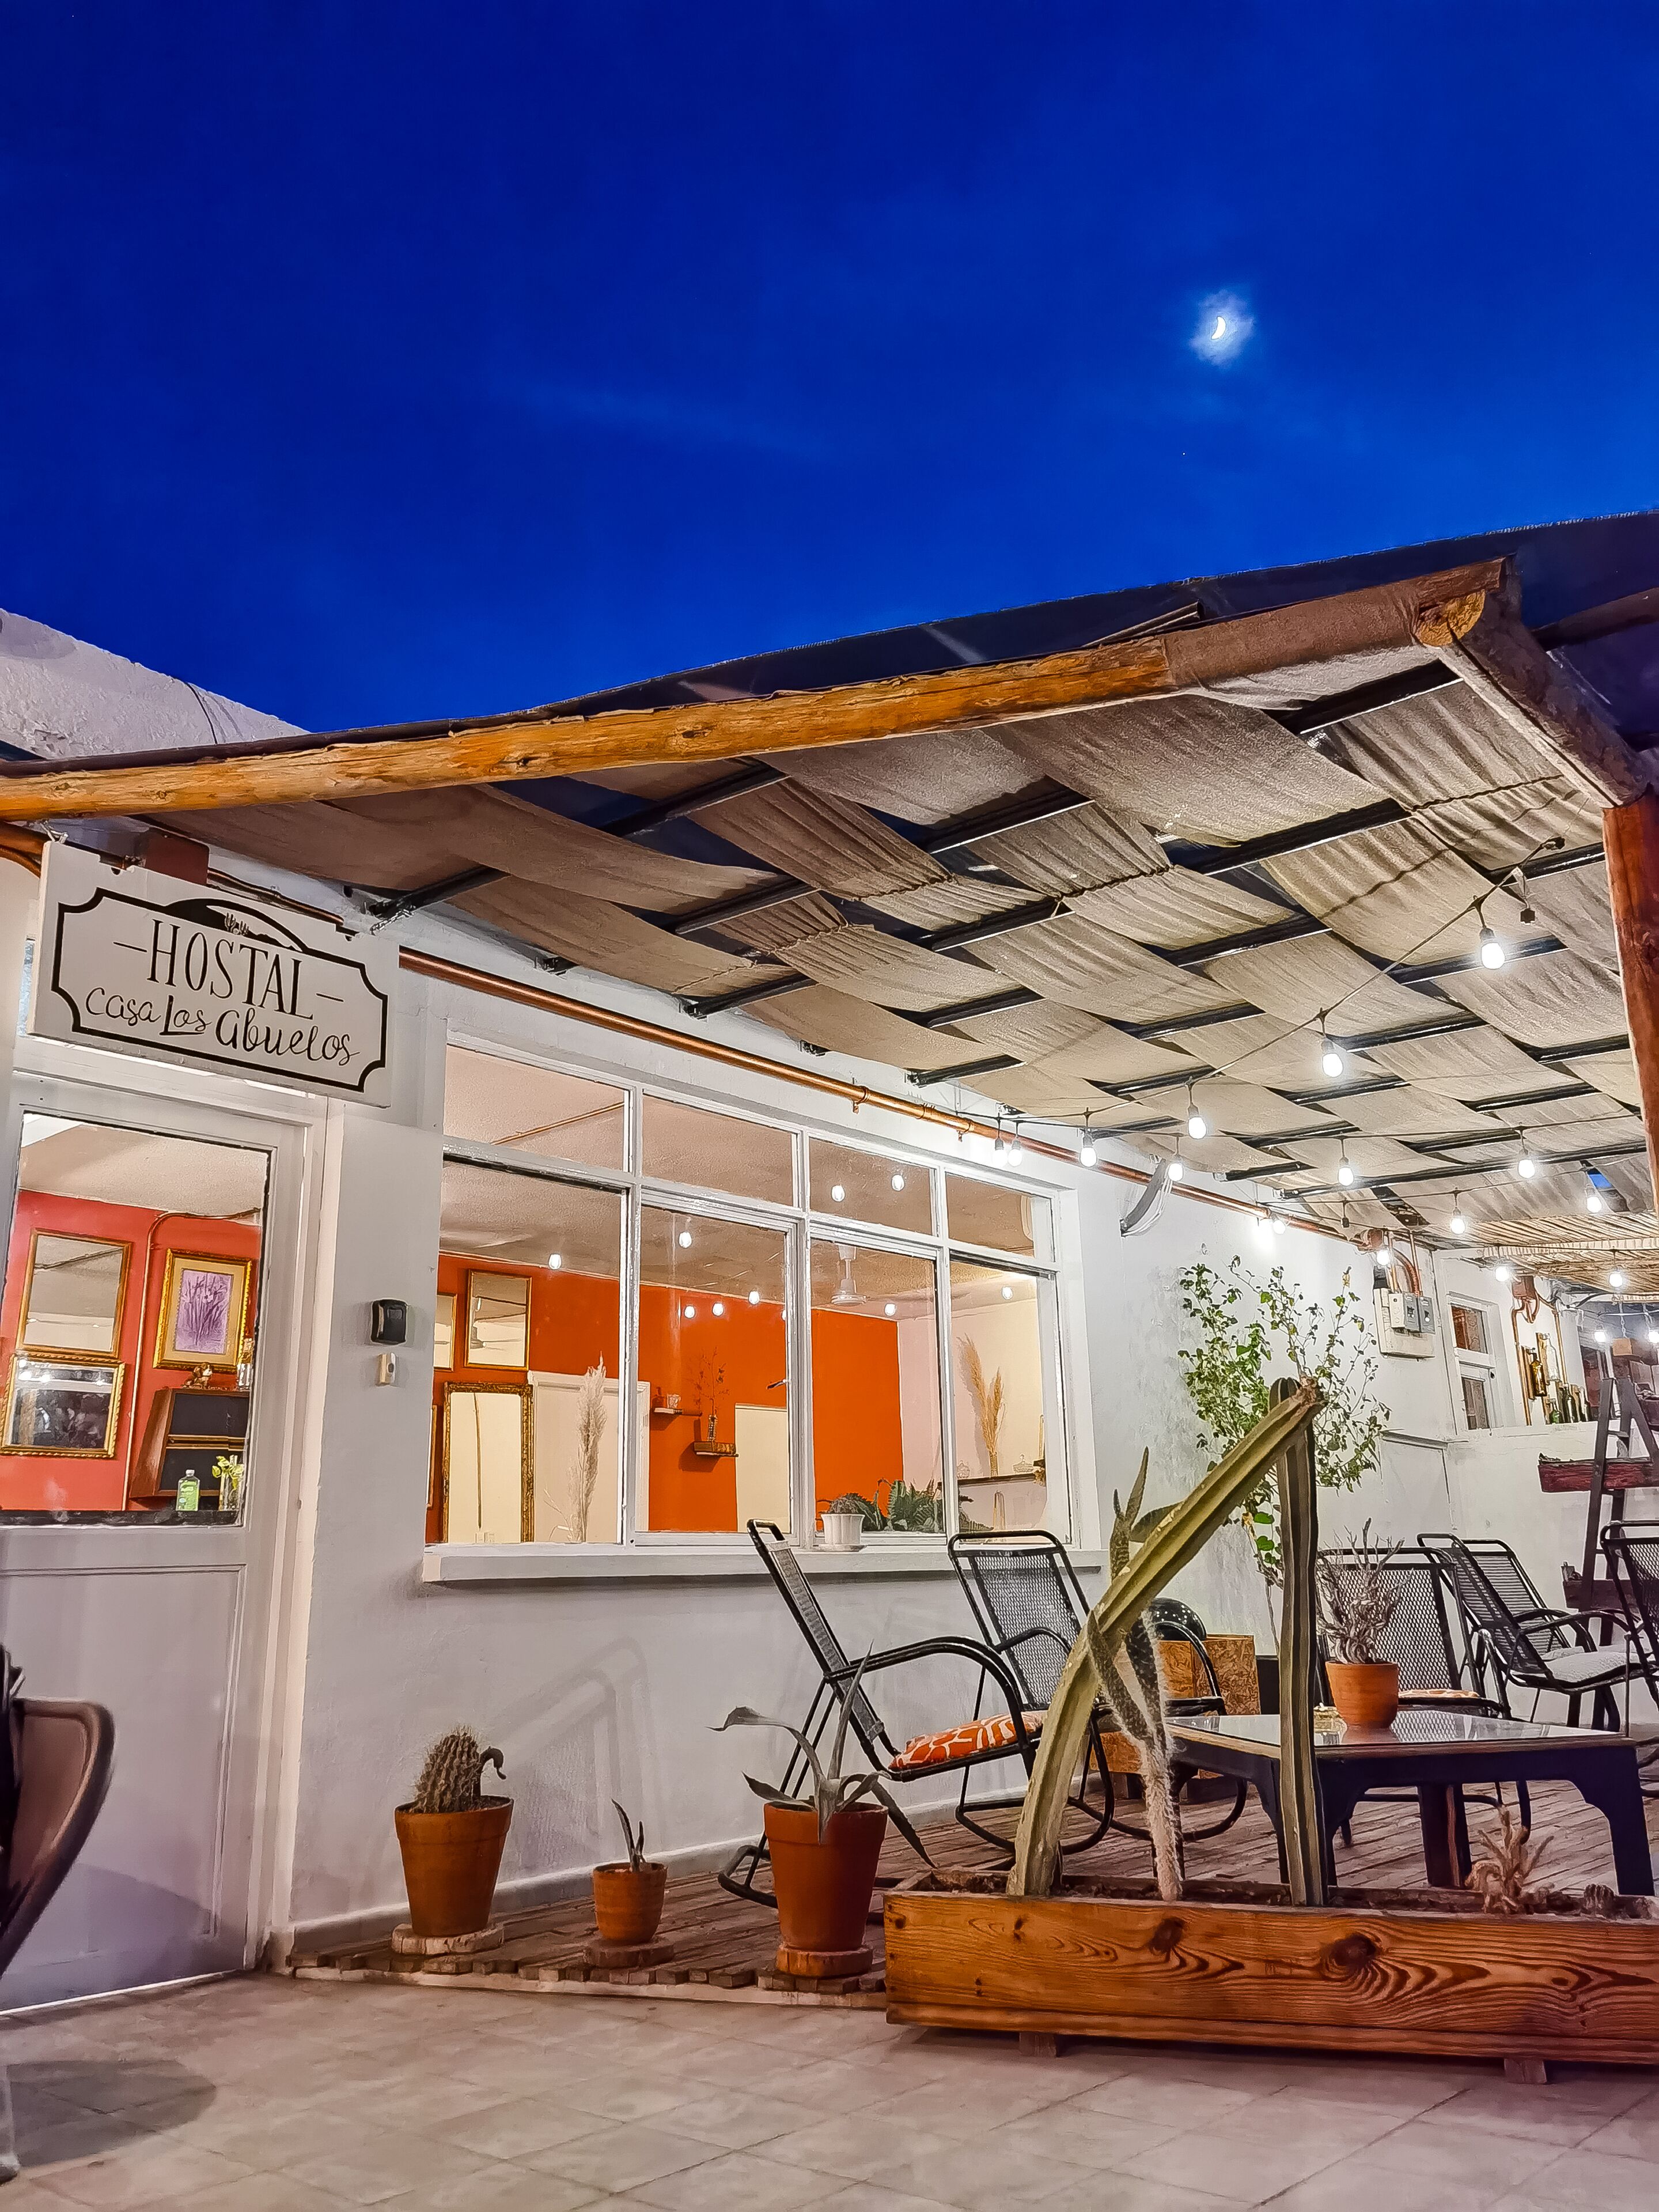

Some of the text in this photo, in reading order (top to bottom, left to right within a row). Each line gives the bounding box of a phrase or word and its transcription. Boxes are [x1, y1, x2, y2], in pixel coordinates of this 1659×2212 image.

[147, 919, 314, 1020] HOSTAL
[85, 987, 361, 1066] Casa Los Abuelos
